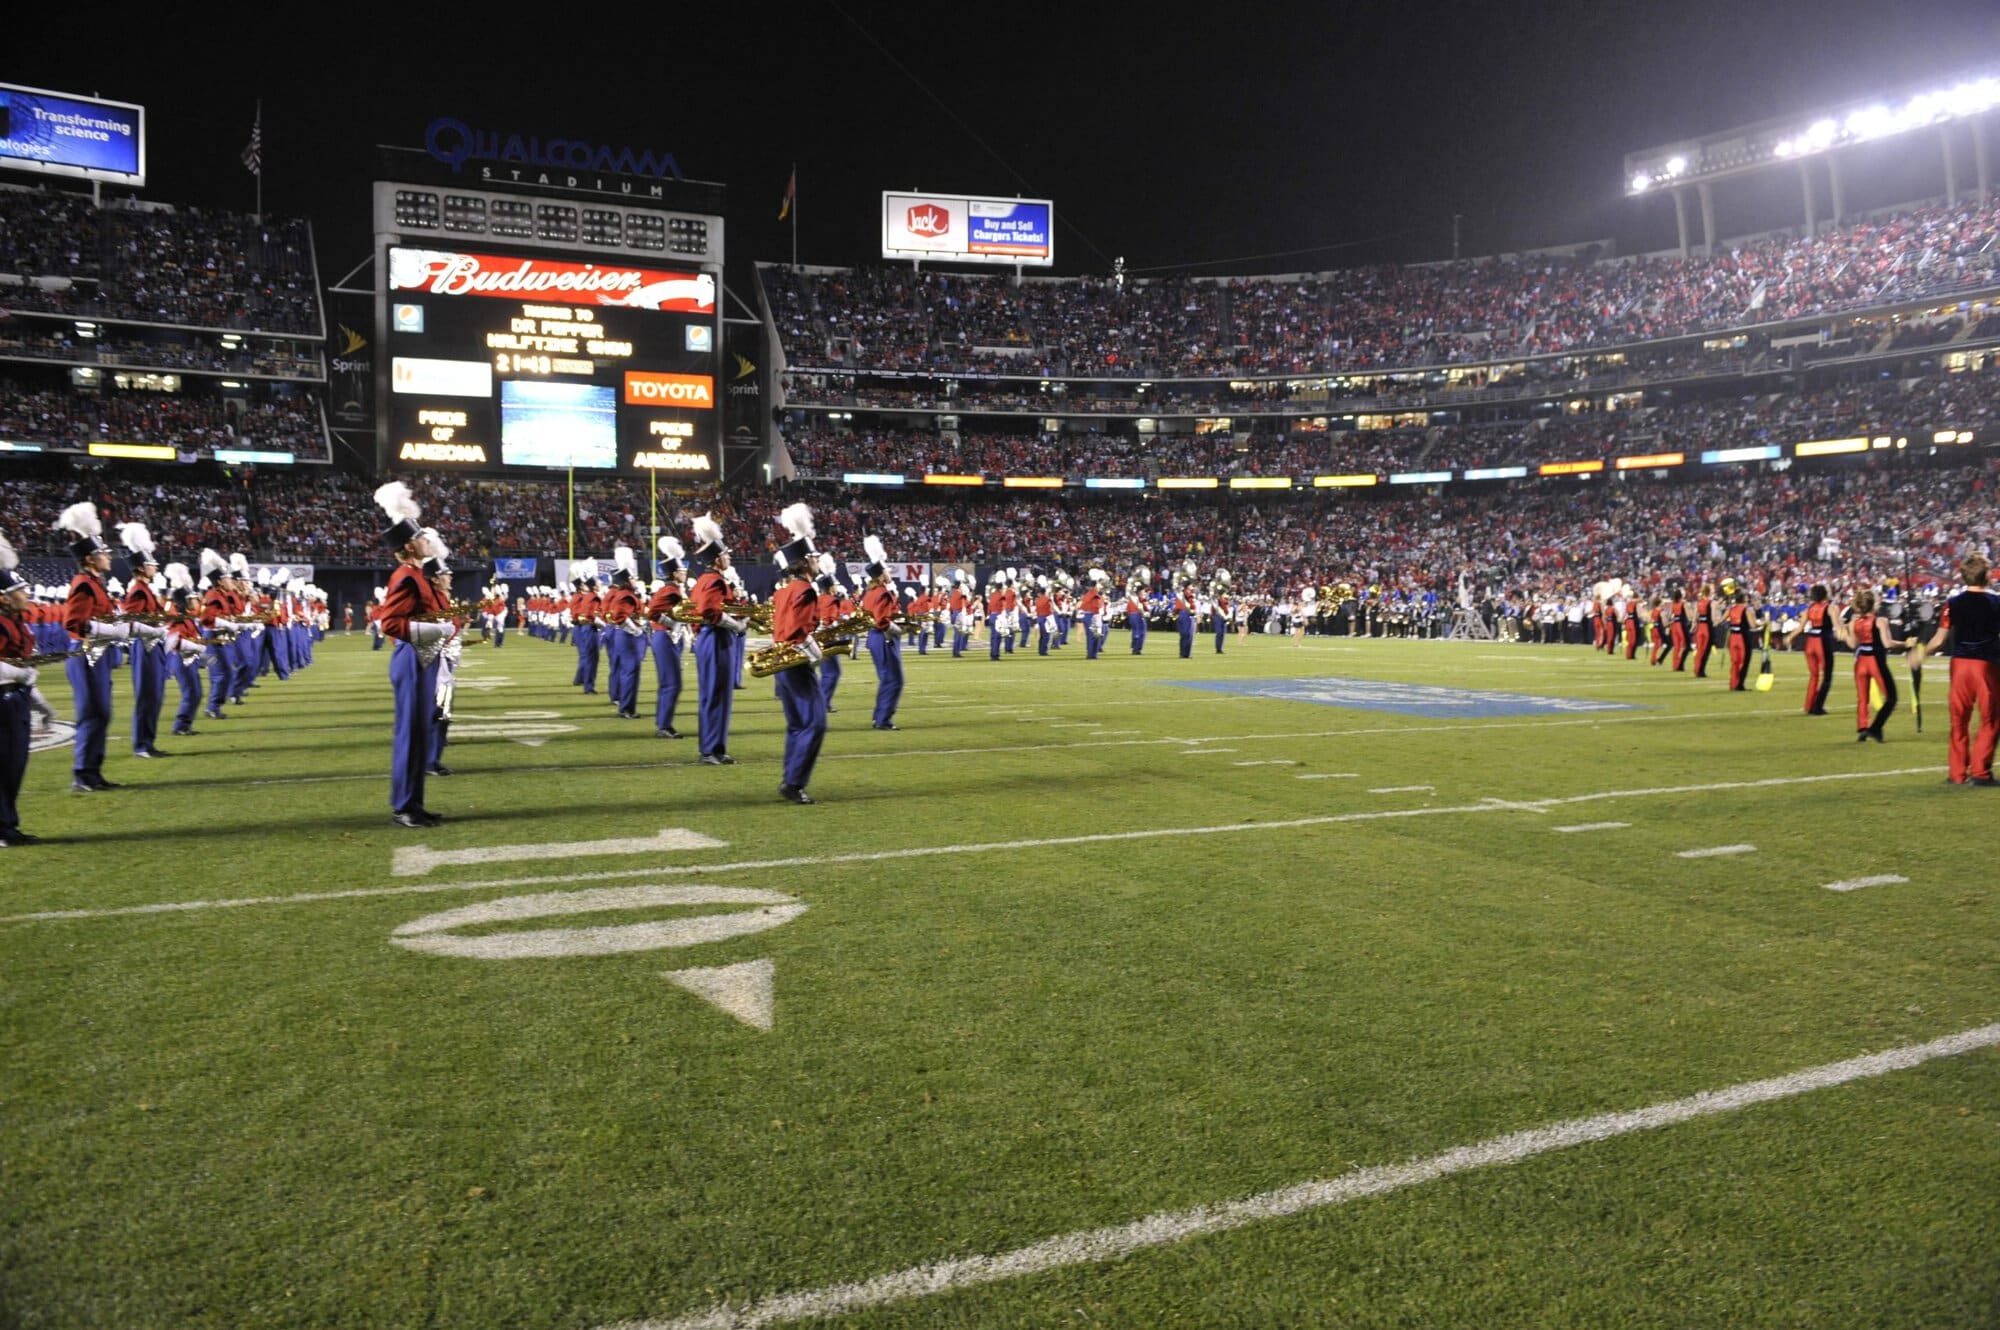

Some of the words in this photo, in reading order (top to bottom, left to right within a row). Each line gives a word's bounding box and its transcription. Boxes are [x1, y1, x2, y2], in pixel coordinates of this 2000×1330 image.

[32, 107, 131, 136] Transforming
[55, 125, 110, 141] science
[425, 117, 682, 180] QUALCOMM
[482, 167, 662, 196] STADIUM
[908, 207, 947, 234] Jack
[984, 219, 1000, 231] Buy
[1001, 221, 1016, 230] and
[1018, 221, 1033, 231] Sell
[973, 229, 1011, 242] Chargers
[425, 254, 643, 295] Budweiser
[511, 317, 536, 334] DR
[541, 320, 604, 338] PEPPER
[332, 358, 370, 374] Sprint
[629, 381, 710, 400] TOYOTA
[728, 382, 760, 397] Sprint
[432, 427, 454, 441] OF
[400, 442, 487, 462] ARIZONA
[661, 438, 682, 450] OF
[633, 452, 710, 470] ARIZONA
[906, 565, 923, 581] N
